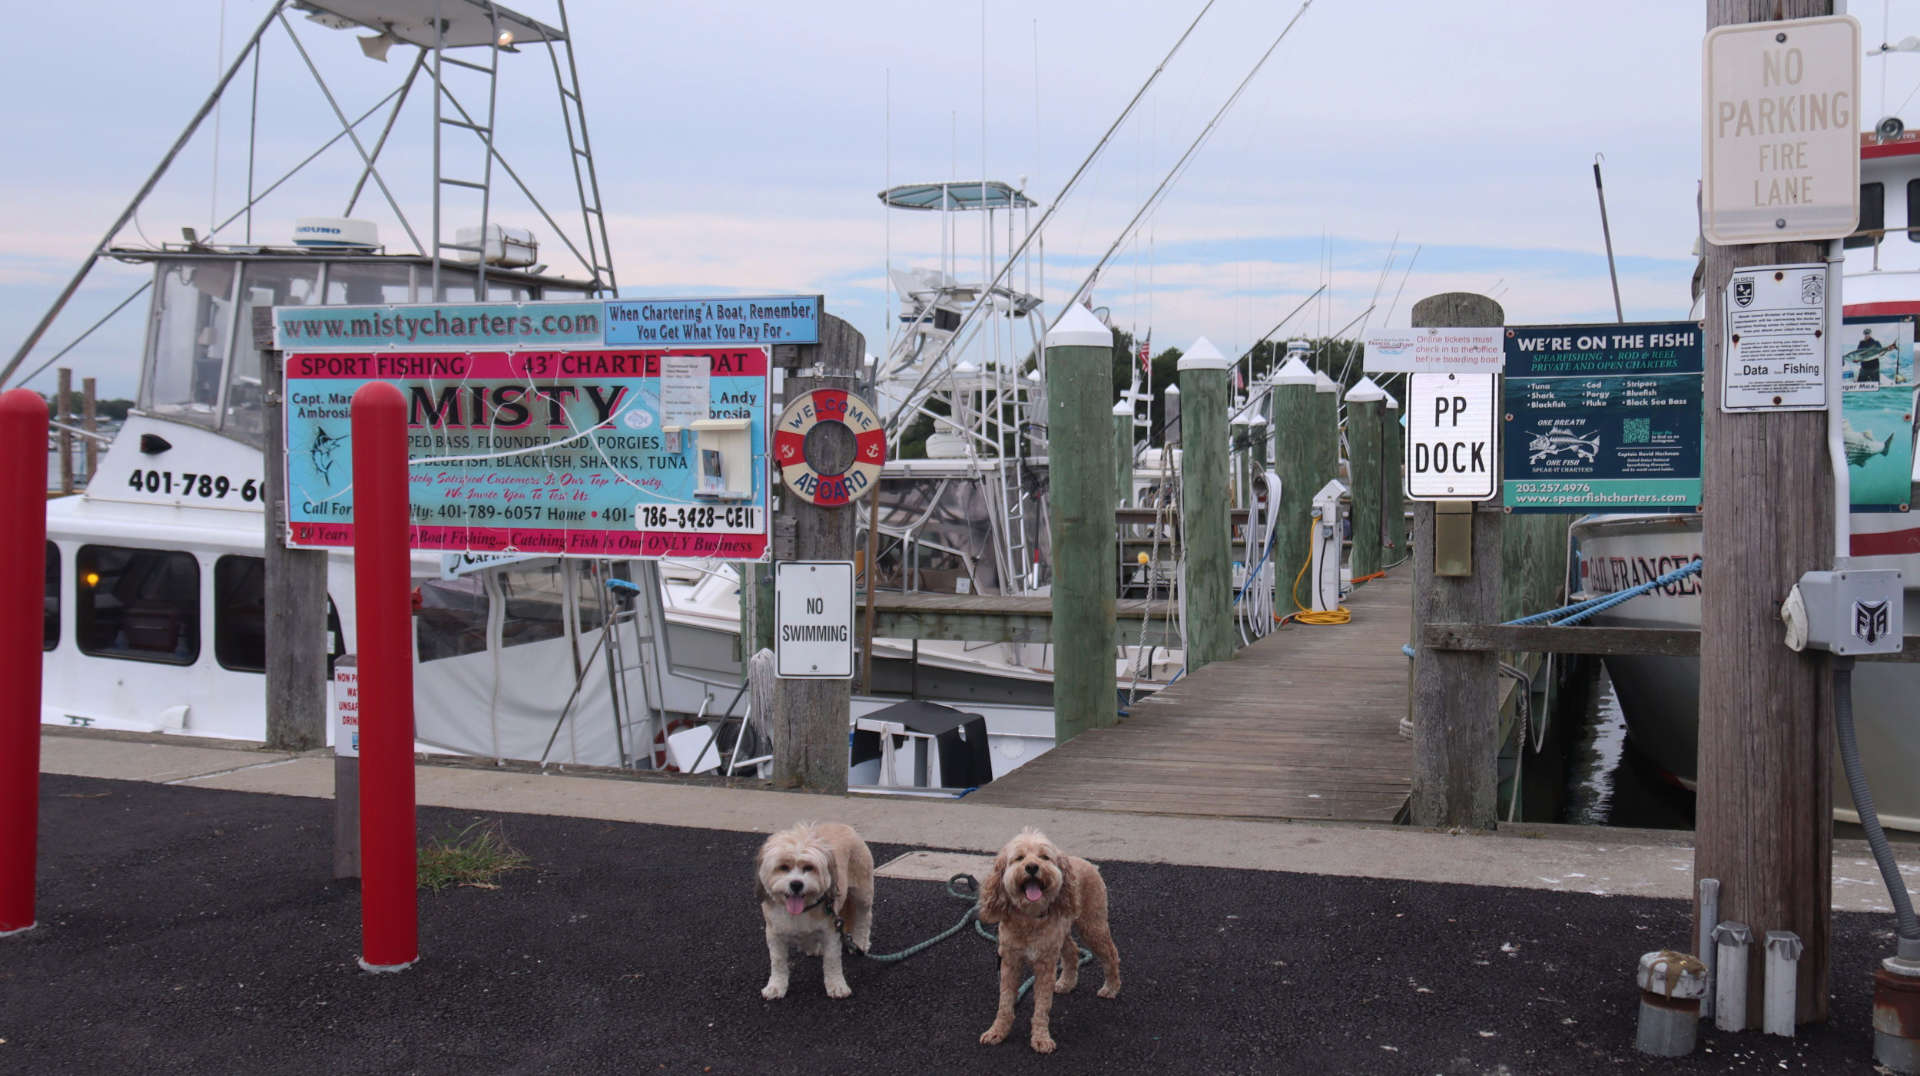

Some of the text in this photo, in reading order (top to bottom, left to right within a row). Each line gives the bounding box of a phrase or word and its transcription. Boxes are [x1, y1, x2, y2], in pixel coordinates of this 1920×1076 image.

[1762, 47, 1804, 87] NO
[1718, 91, 1849, 138] PARKING
[1759, 142, 1809, 172] FIRE
[1753, 176, 1813, 208] LANE
[609, 302, 815, 323] When Chartering A Boat, Remember,
[284, 310, 600, 341] www.mistycharters.com
[637, 323, 782, 342] You Get What You Pay For
[1416, 336, 1442, 344] Online
[1577, 336, 1606, 350] ON
[1612, 335, 1644, 349] THE
[1650, 332, 1695, 348] FISH!
[1461, 345, 1475, 353] the
[1477, 345, 1498, 353] office
[1533, 353, 1602, 361] SPEARFISHING
[1618, 351, 1639, 360] ROD
[1652, 350, 1676, 359] REEL
[301, 358, 371, 375] SPORT
[377, 357, 466, 375] FISHING
[561, 354, 657, 374] CHARTE
[1415, 355, 1440, 364] before
[1443, 356, 1479, 365] boarding
[1531, 359, 1679, 371] PRIVATE AND OPEN CHARTERS
[1743, 363, 1819, 377] Data Fishing
[1627, 380, 1657, 389] Stripers
[292, 393, 352, 406] Capt. Mar
[720, 391, 757, 405] Andy
[1626, 389, 1657, 397] Bluefish
[408, 384, 629, 429] MISTY
[1531, 400, 1566, 409] Blackfish
[1626, 398, 1687, 407] Black Sea Bass
[709, 408, 751, 419] brosia
[789, 398, 873, 430] WELCOME
[1434, 396, 1468, 428] PP
[1537, 418, 1586, 427] ONE BREATH
[600, 436, 663, 450] PORGIES,
[497, 455, 575, 470] BLACKFISH,
[580, 456, 643, 470] SHARKS,
[648, 456, 688, 469] TUNA
[1415, 441, 1486, 474] DOCK
[129, 469, 265, 502] 401-789-6
[486, 473, 540, 485] Customers
[560, 473, 584, 487] Our
[793, 470, 868, 500] ABOARD
[1516, 484, 1590, 493] 203.257.4976
[1516, 492, 1686, 505] www.spearfishcharters.com
[303, 501, 352, 515] Call For
[437, 504, 542, 519] 401-789-6057
[548, 508, 586, 521] Home
[511, 532, 566, 548] Catching
[571, 535, 599, 549] Fish
[648, 537, 692, 551] ONLY
[695, 538, 753, 552] Business
[806, 598, 824, 615] NO
[782, 624, 848, 642] SWIMMING
[339, 702, 358, 711] UNSAF
[342, 716, 358, 725] DRIN
